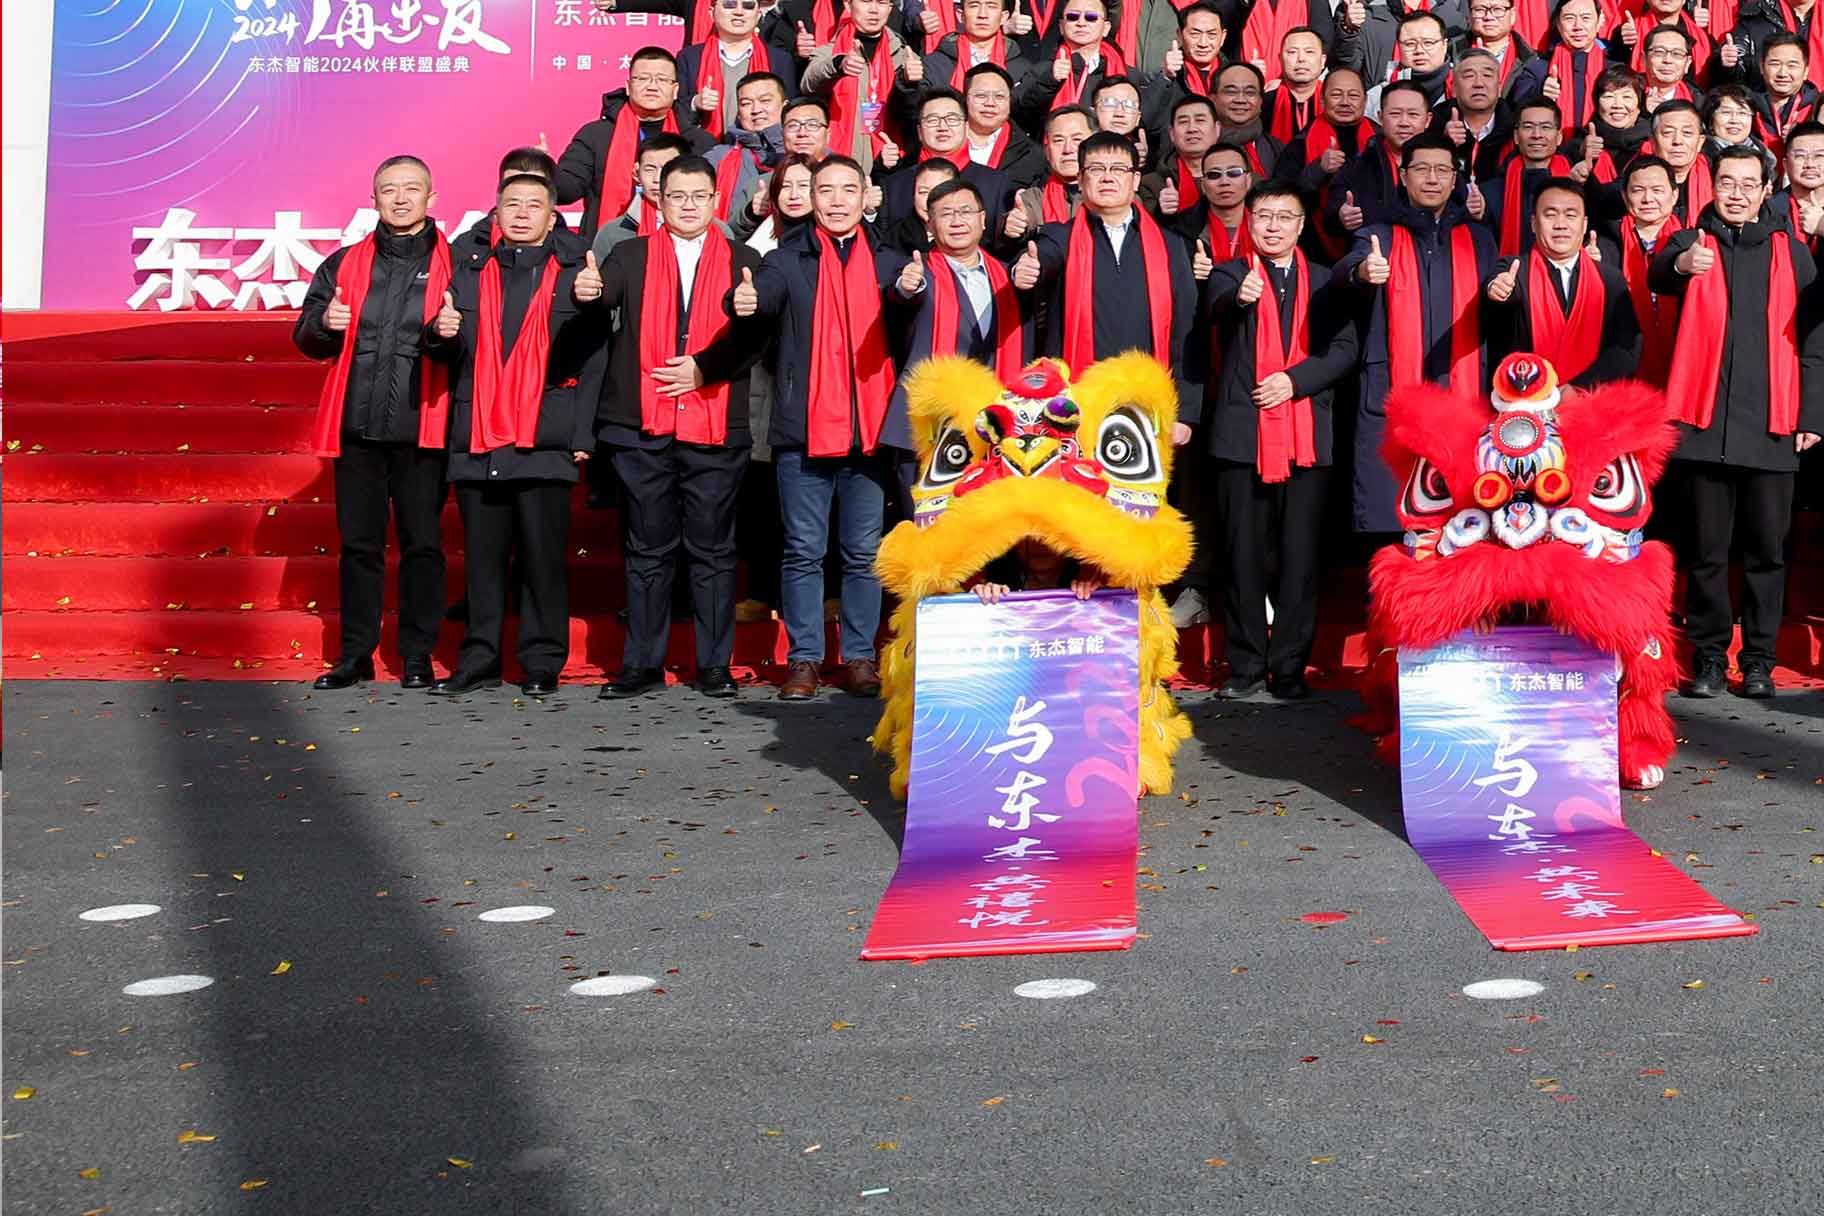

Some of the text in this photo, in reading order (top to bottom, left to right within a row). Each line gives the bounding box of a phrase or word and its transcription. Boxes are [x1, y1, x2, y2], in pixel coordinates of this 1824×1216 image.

[231, 11, 301, 47] 2024
[248, 54, 471, 74] 东杰智能2024伙伴联盟盛典
[1029, 635, 1105, 659] 东杰智能
[1509, 671, 1585, 692] 东杰智能
